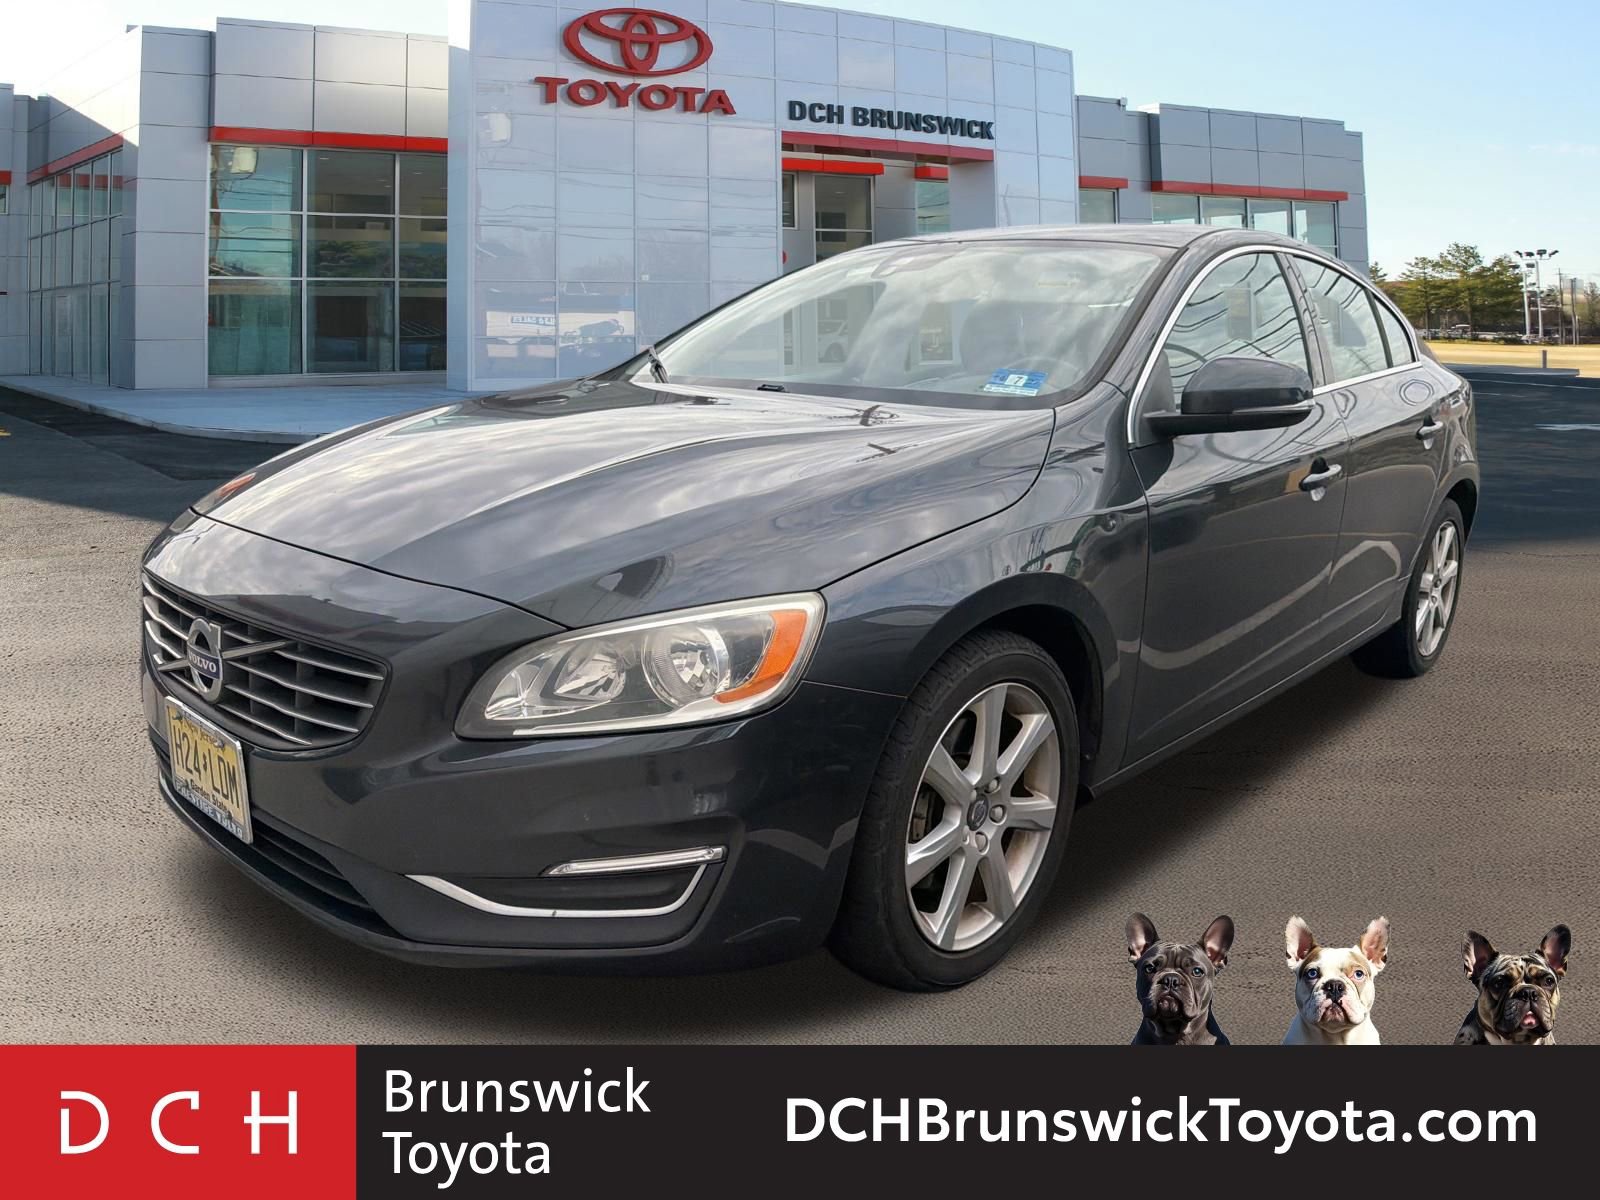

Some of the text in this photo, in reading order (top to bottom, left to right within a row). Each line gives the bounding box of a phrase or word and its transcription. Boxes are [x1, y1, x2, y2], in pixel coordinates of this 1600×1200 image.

[535, 76, 736, 115] TOYOTA
[788, 100, 994, 140] DCH BRUNSWICK
[190, 651, 217, 673] VOLVO
[173, 725, 240, 809] H24 LDM
